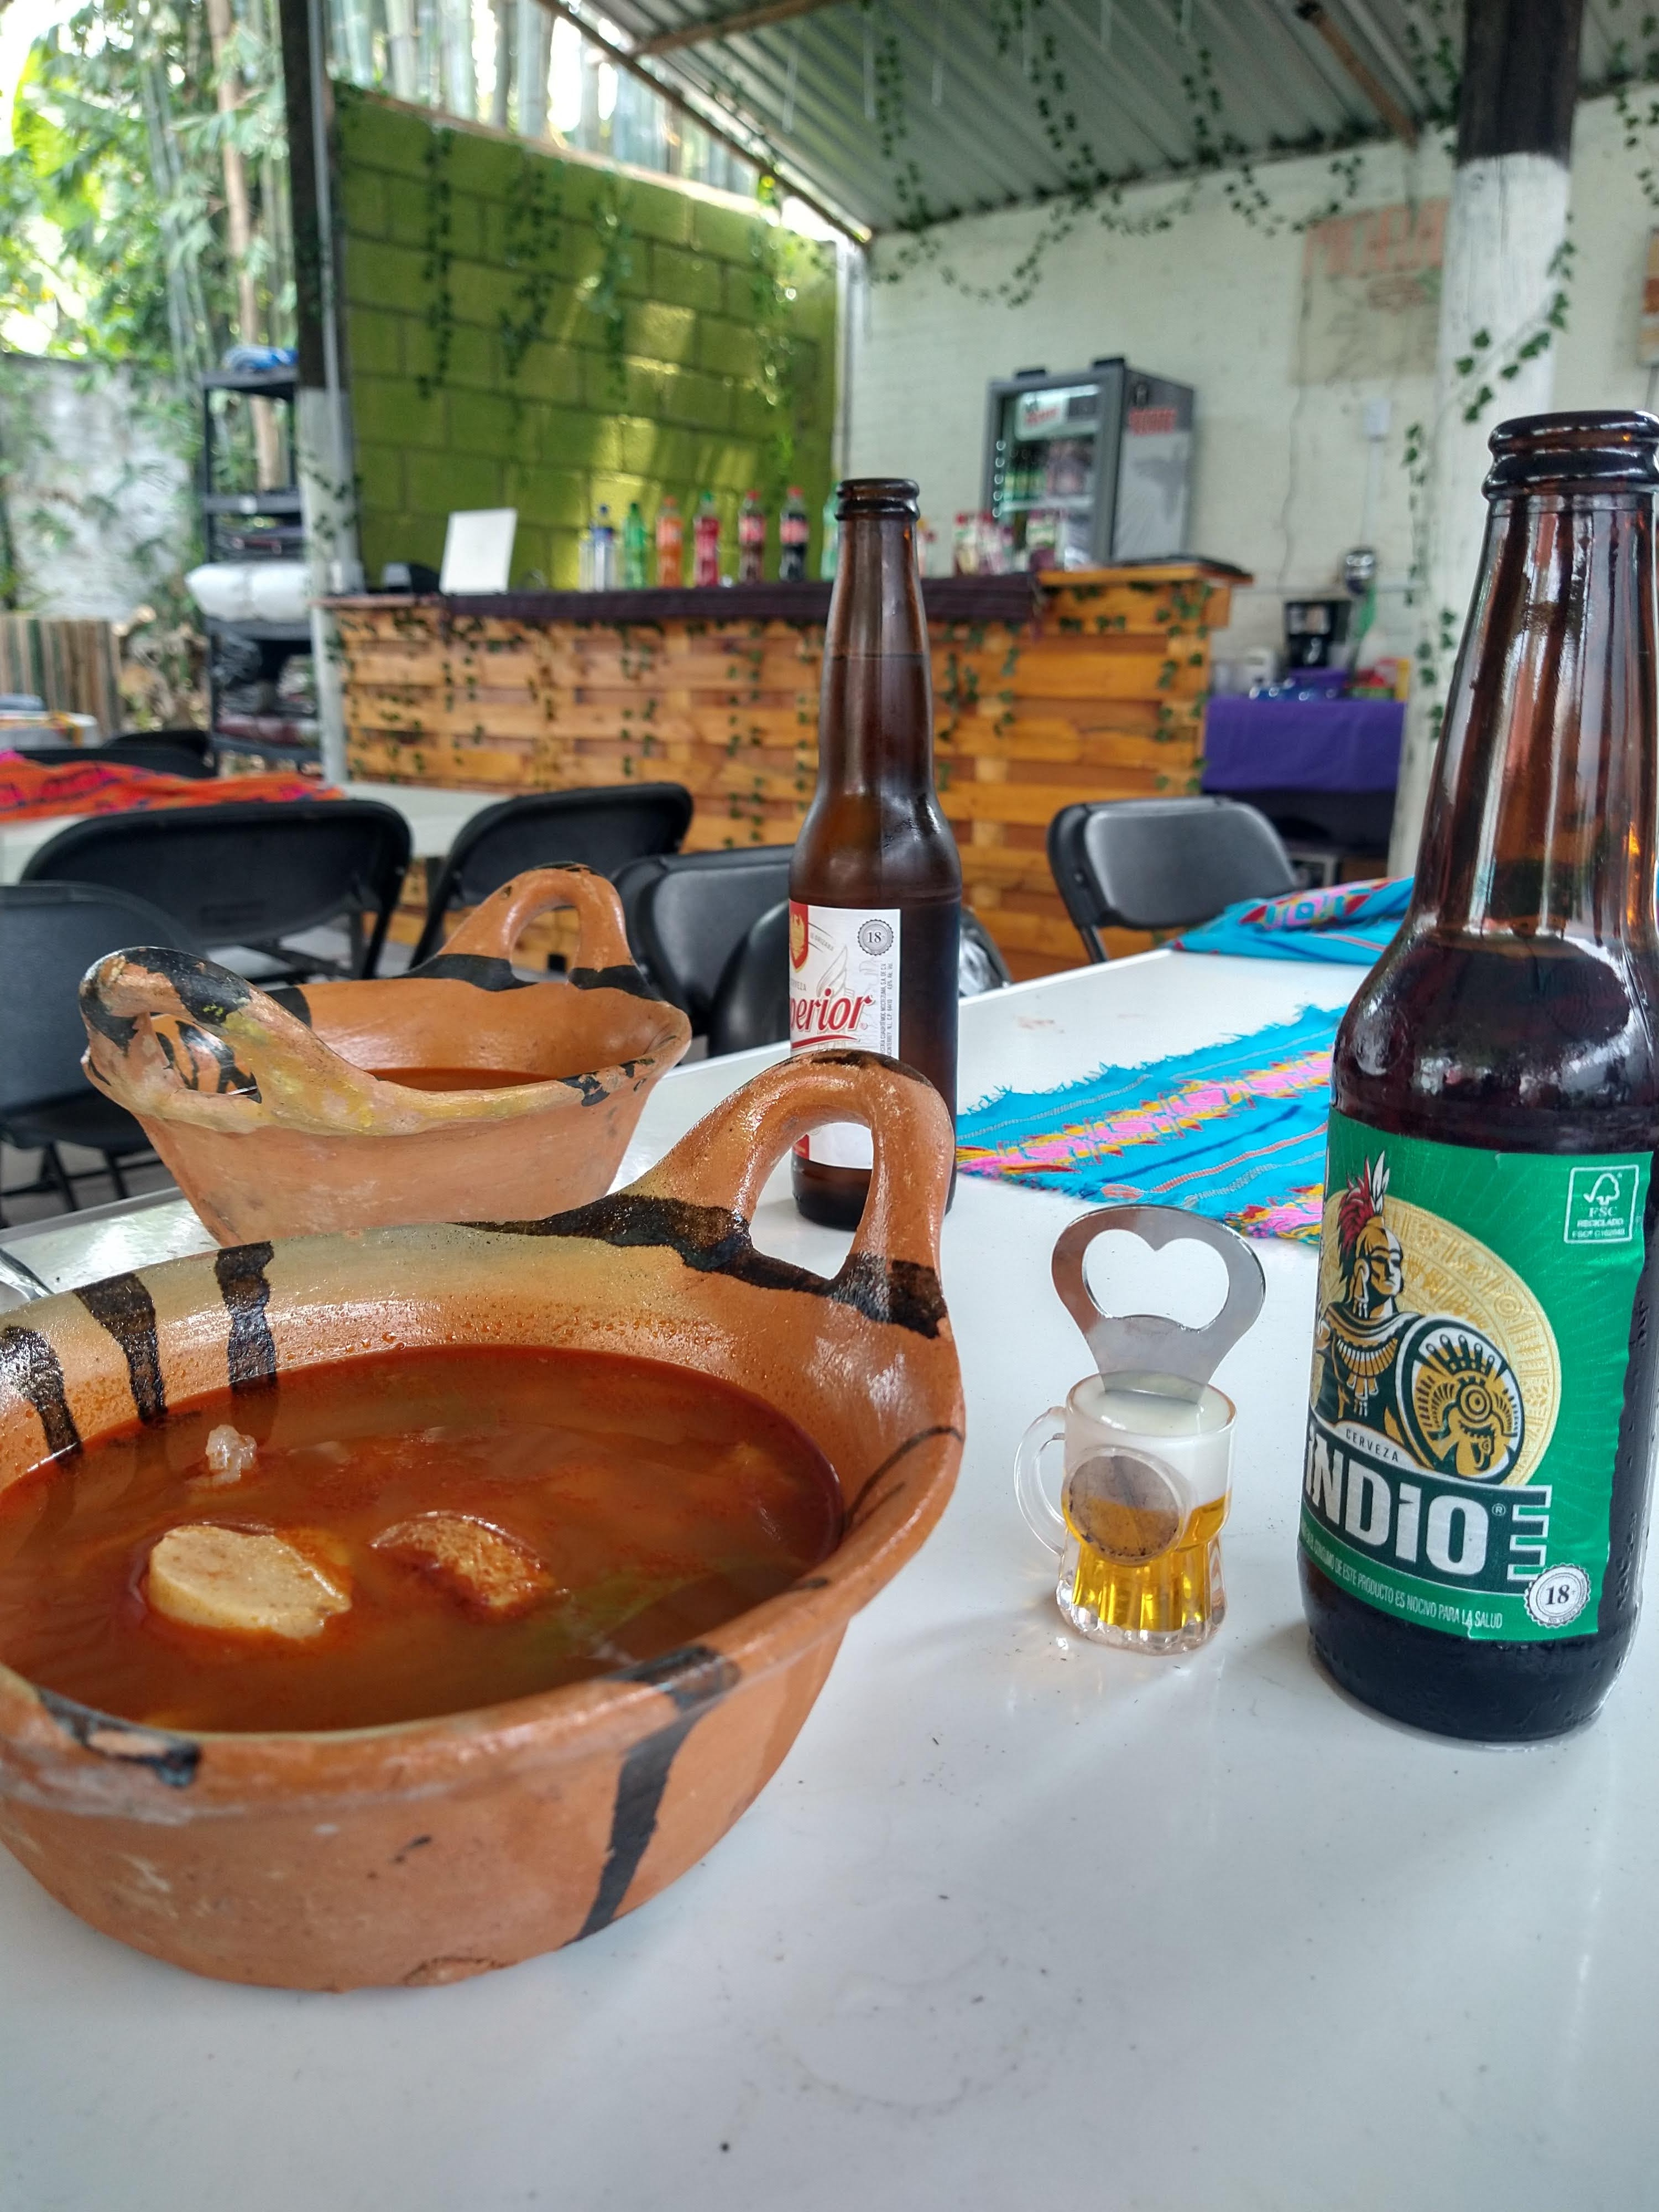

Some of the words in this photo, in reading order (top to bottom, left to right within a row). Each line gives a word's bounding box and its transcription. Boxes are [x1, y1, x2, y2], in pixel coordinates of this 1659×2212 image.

[1345, 1428, 1399, 1463] CERVEZA
[1343, 1563, 1357, 1586] ESTE
[1358, 1573, 1394, 1604] PRODUCTO
[1395, 1590, 1406, 1609] ES
[1407, 1594, 1437, 1618] NOCIVO
[1438, 1604, 1460, 1623] PARA
[1462, 1609, 1473, 1628] LA
[1474, 1610, 1504, 1629] SALUD
